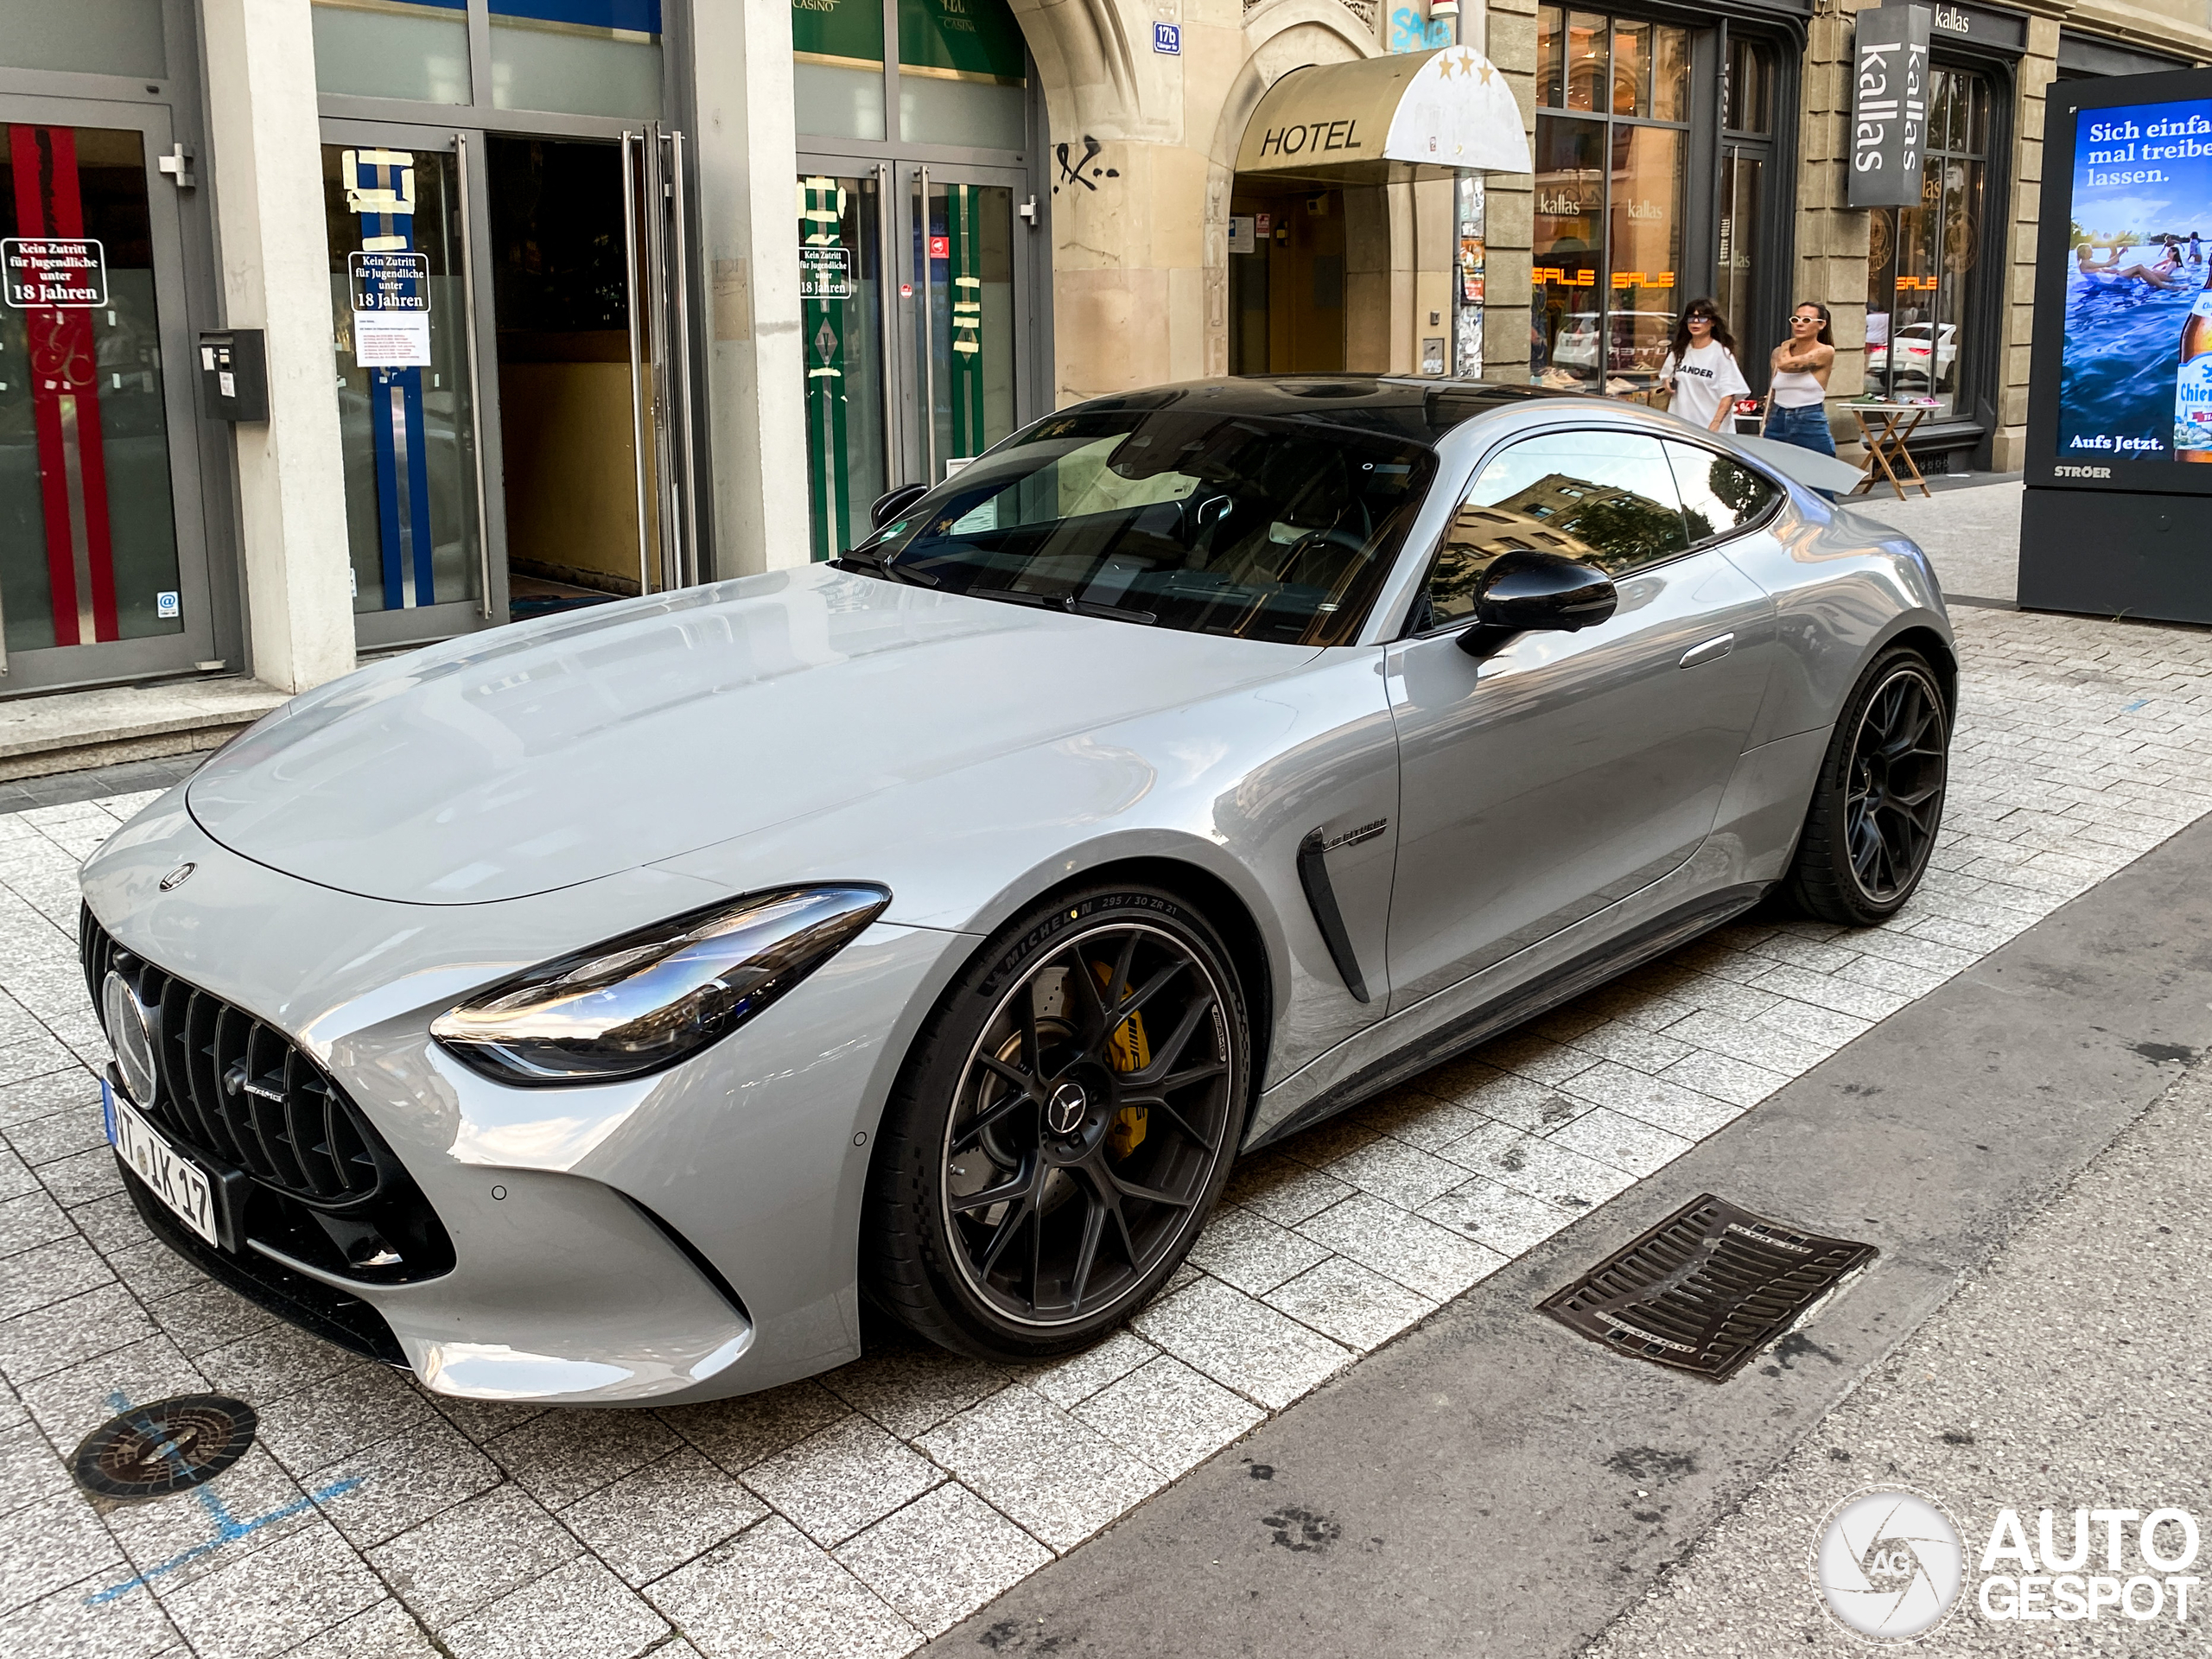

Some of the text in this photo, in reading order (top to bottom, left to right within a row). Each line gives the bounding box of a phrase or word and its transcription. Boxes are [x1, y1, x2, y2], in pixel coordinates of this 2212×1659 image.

[792, 0, 834, 12] CASINO
[944, 18, 976, 33] CASIN
[1935, 3, 1969, 33] kallas
[1158, 26, 1176, 43] 17b
[1855, 43, 1901, 172] kallas
[1903, 43, 1926, 170] kallas
[2089, 114, 2212, 143] Sich einfa
[1260, 119, 1361, 157] HOTEL
[2088, 138, 2212, 164] mal treibe
[1922, 171, 1941, 200] las
[2087, 168, 2170, 188] lassen.
[1540, 193, 1580, 215] kallas
[1627, 199, 1663, 219] kallas
[18, 243, 88, 255] Kein Zutritt
[804, 251, 842, 260] Kein Zutritt
[10, 256, 99, 270] für Jugendliche
[362, 256, 416, 267] Kein Zutritt
[799, 260, 847, 271] für Jugendliche
[39, 271, 73, 281] unter
[355, 267, 424, 281] für Jugendliche
[1531, 267, 1595, 286] SALE
[1611, 271, 1675, 289] SALE
[1896, 276, 1938, 290] SALE
[13, 283, 98, 302] 18 Jahren
[378, 281, 404, 289] unter
[801, 281, 846, 295] 18 Jahren
[358, 292, 423, 309] 18 Jahren
[2069, 435, 2164, 454] Aufs Jetzt.
[2054, 465, 2111, 479] STRÖER
[1102, 895, 1122, 907] 295
[1134, 895, 1148, 906] 30
[1149, 899, 1165, 910] ZR
[1166, 904, 1178, 915] 21
[179, 1167, 207, 1230] 17
